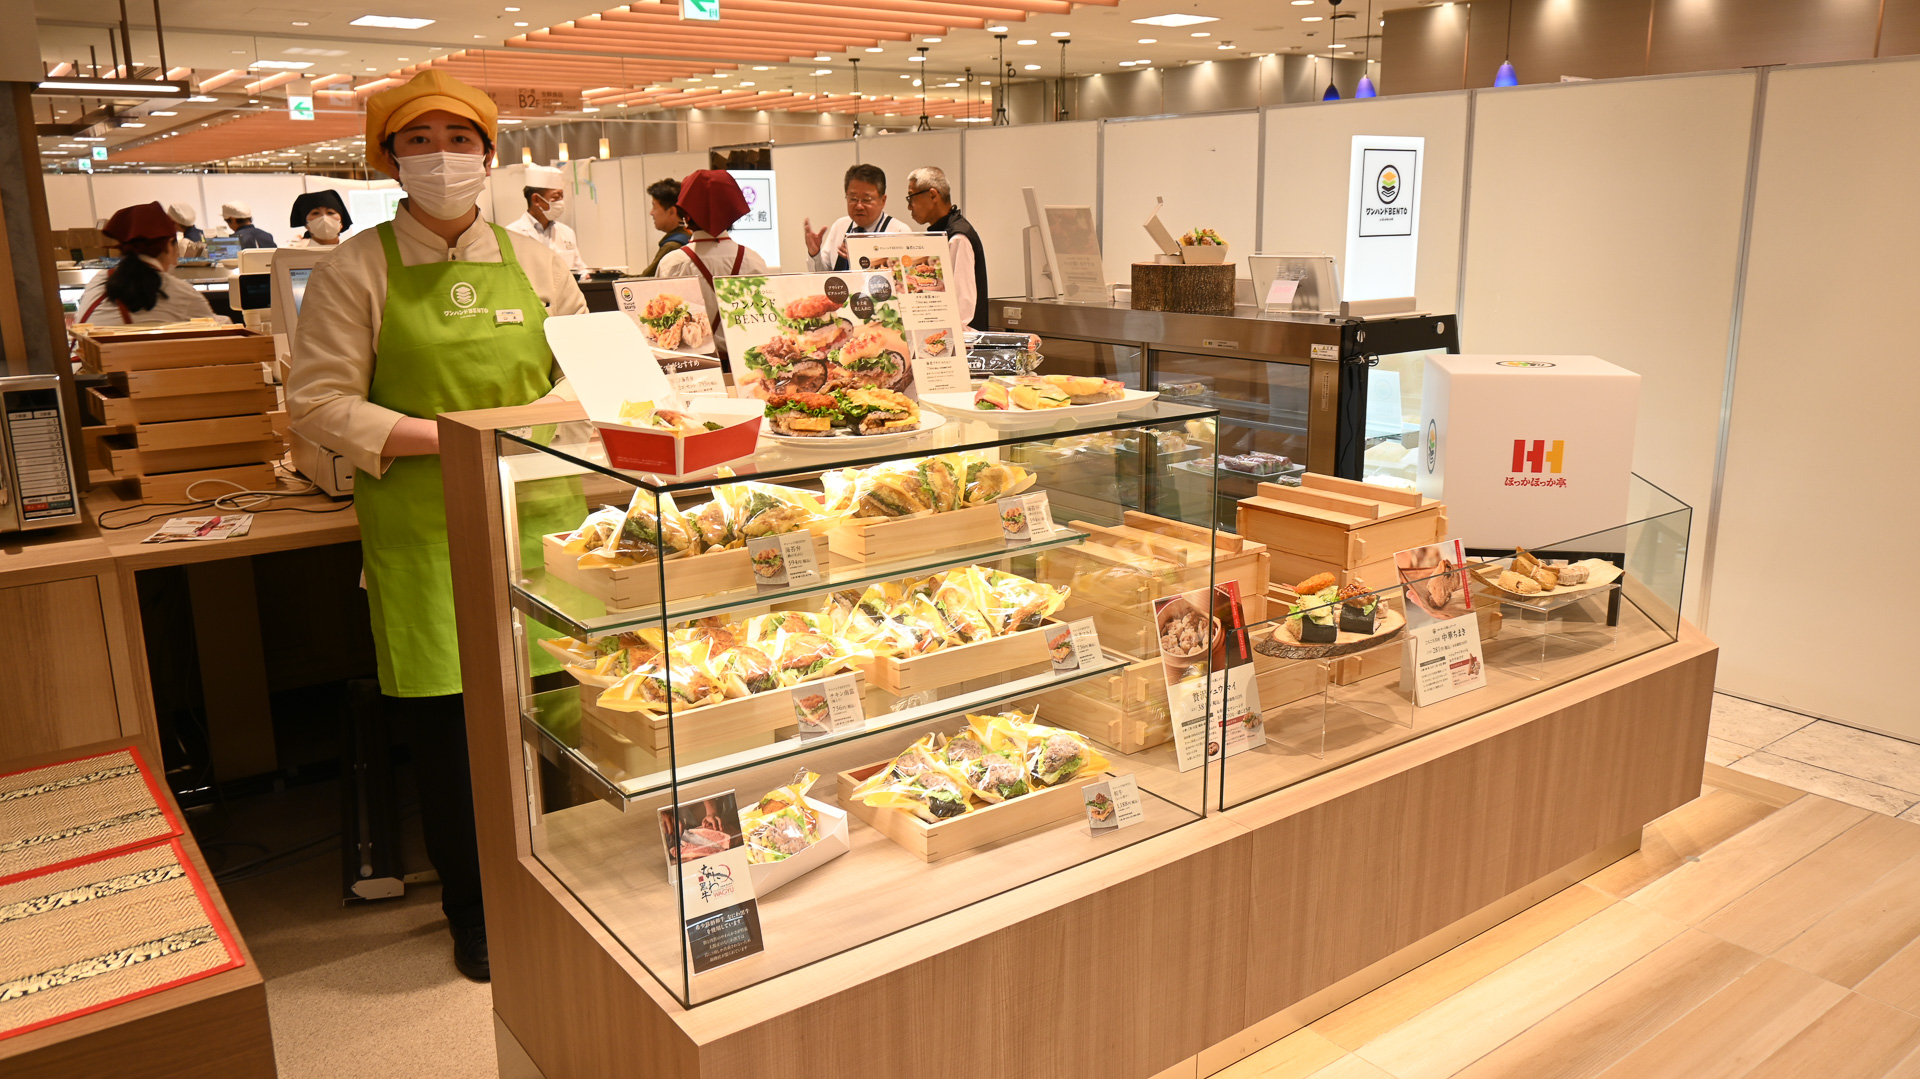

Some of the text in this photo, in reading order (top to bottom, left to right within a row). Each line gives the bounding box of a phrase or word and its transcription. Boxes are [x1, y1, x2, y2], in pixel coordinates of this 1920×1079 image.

[1365, 207, 1408, 216] ワンハンドBENTO
[731, 298, 776, 310] ワンハンド
[443, 307, 489, 317] ワンハンドBENTO
[734, 312, 777, 325] BENTO
[1504, 476, 1568, 489] ほっかほっか亭
[1441, 627, 1466, 642] 中華ちまき
[713, 886, 735, 898] WAGYU
